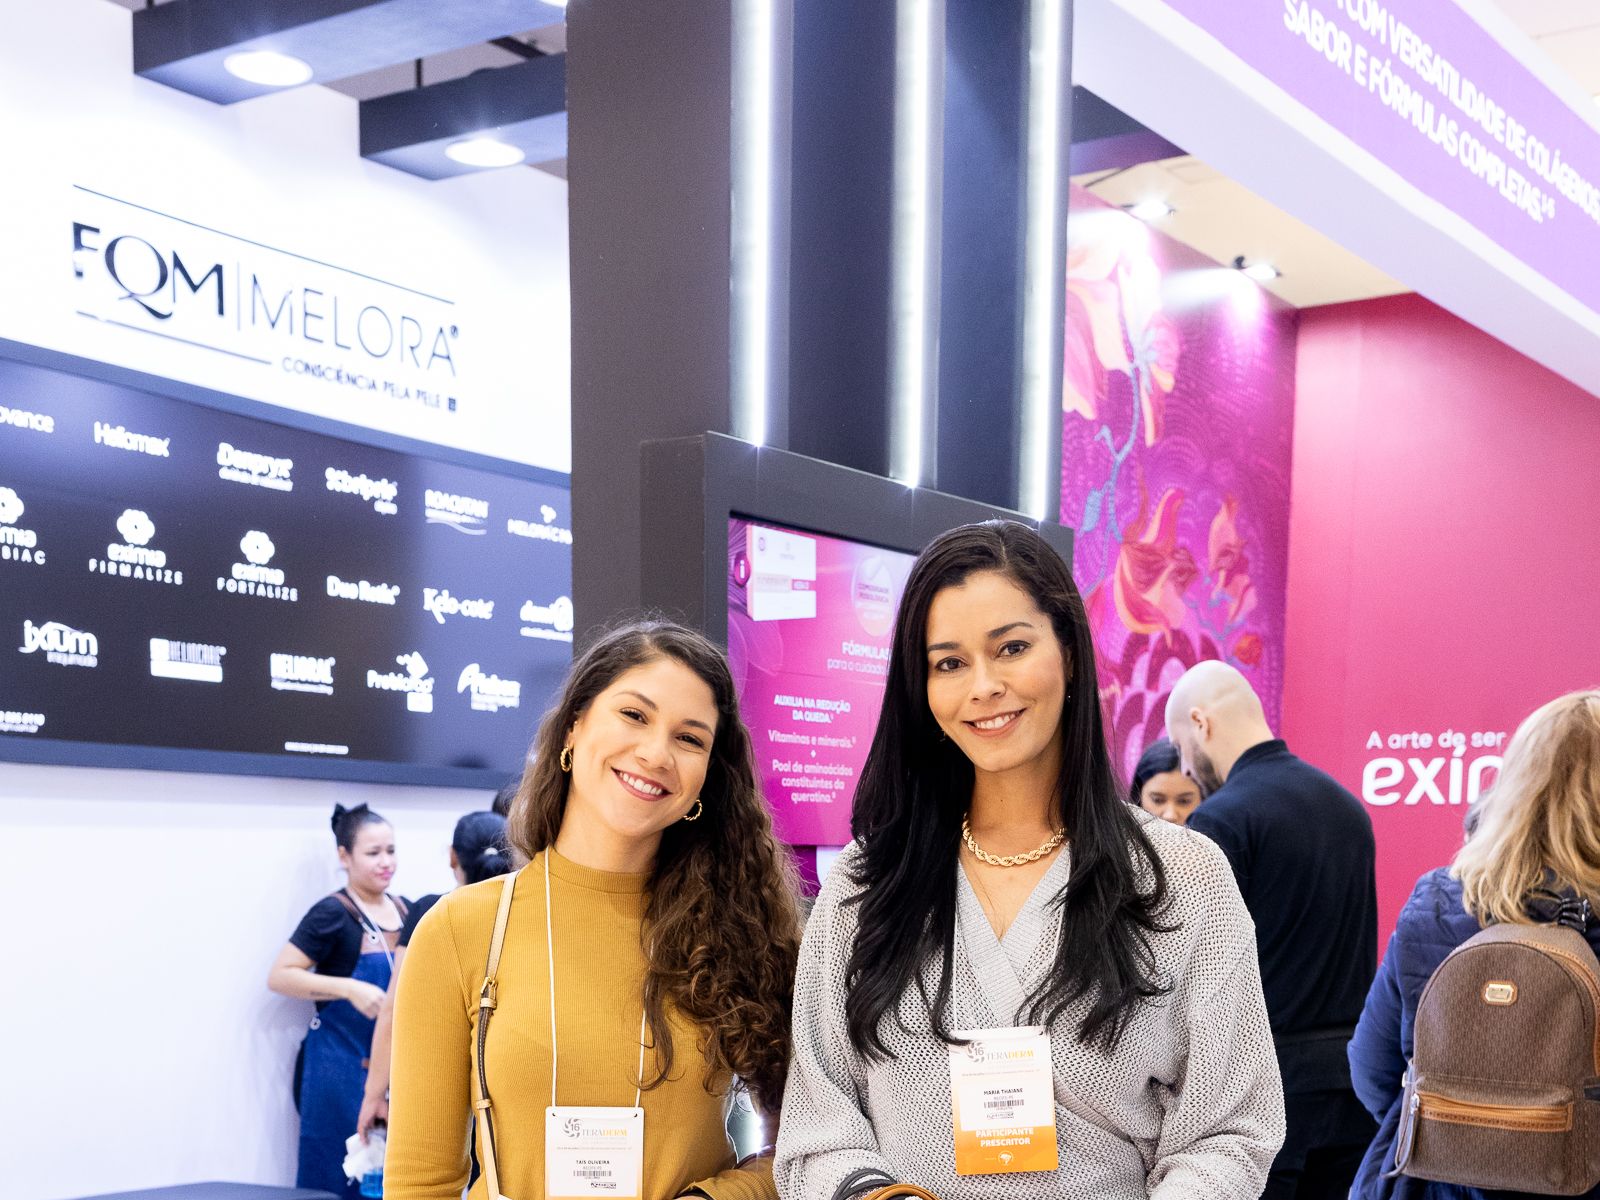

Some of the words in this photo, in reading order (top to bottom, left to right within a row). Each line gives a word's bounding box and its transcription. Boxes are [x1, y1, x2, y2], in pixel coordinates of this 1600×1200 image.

[1283, 0, 1352, 75] SABOR
[1353, 43, 1368, 87] E
[1368, 58, 1458, 157] FÓRMULAS
[1389, 14, 1506, 144] VERSATILIDADE
[1505, 115, 1526, 160] DE
[72, 220, 225, 320] FQM
[383, 380, 410, 400] PELA
[88, 558, 184, 586] FIRMALIZE
[216, 576, 299, 602] FORTALIZE
[804, 697, 816, 708] NA
[816, 698, 851, 714] REDUÇÃO
[792, 709, 804, 720] DA
[768, 729, 810, 745] Vitaminas
[811, 735, 817, 745] e
[1366, 730, 1383, 750] A
[1387, 731, 1433, 749] arte
[1437, 729, 1467, 749] de
[1471, 731, 1507, 747] ser
[772, 759, 791, 772] Pool
[791, 761, 803, 773] de
[781, 776, 833, 789] constituintes
[974, 1046, 984, 1056] 16
[570, 1123, 580, 1132] 16
[975, 1127, 1035, 1138] PARTICIPANTE
[980, 1138, 1031, 1148] PRESCRITOR
